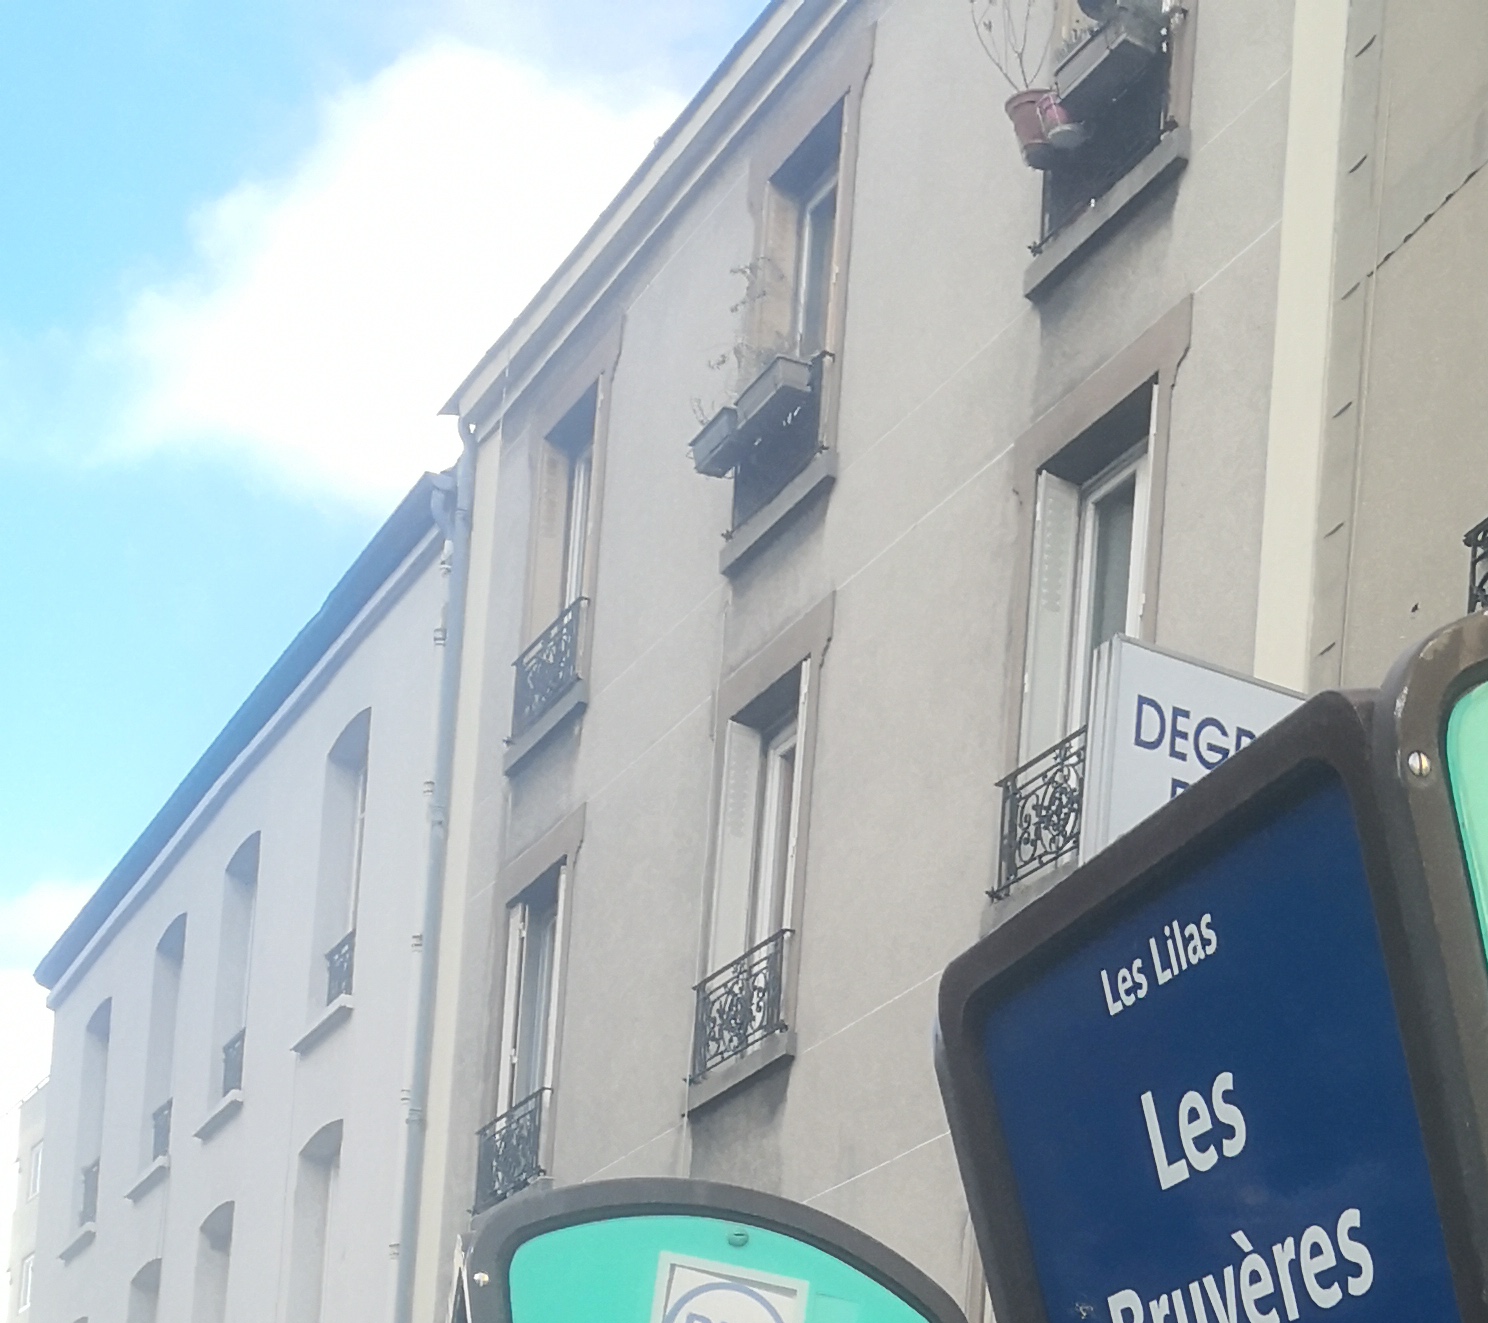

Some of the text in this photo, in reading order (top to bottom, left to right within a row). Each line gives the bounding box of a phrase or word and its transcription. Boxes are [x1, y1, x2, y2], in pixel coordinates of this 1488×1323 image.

[1101, 913, 1218, 1015] Les Lilas
[1141, 1071, 1246, 1190] Les
